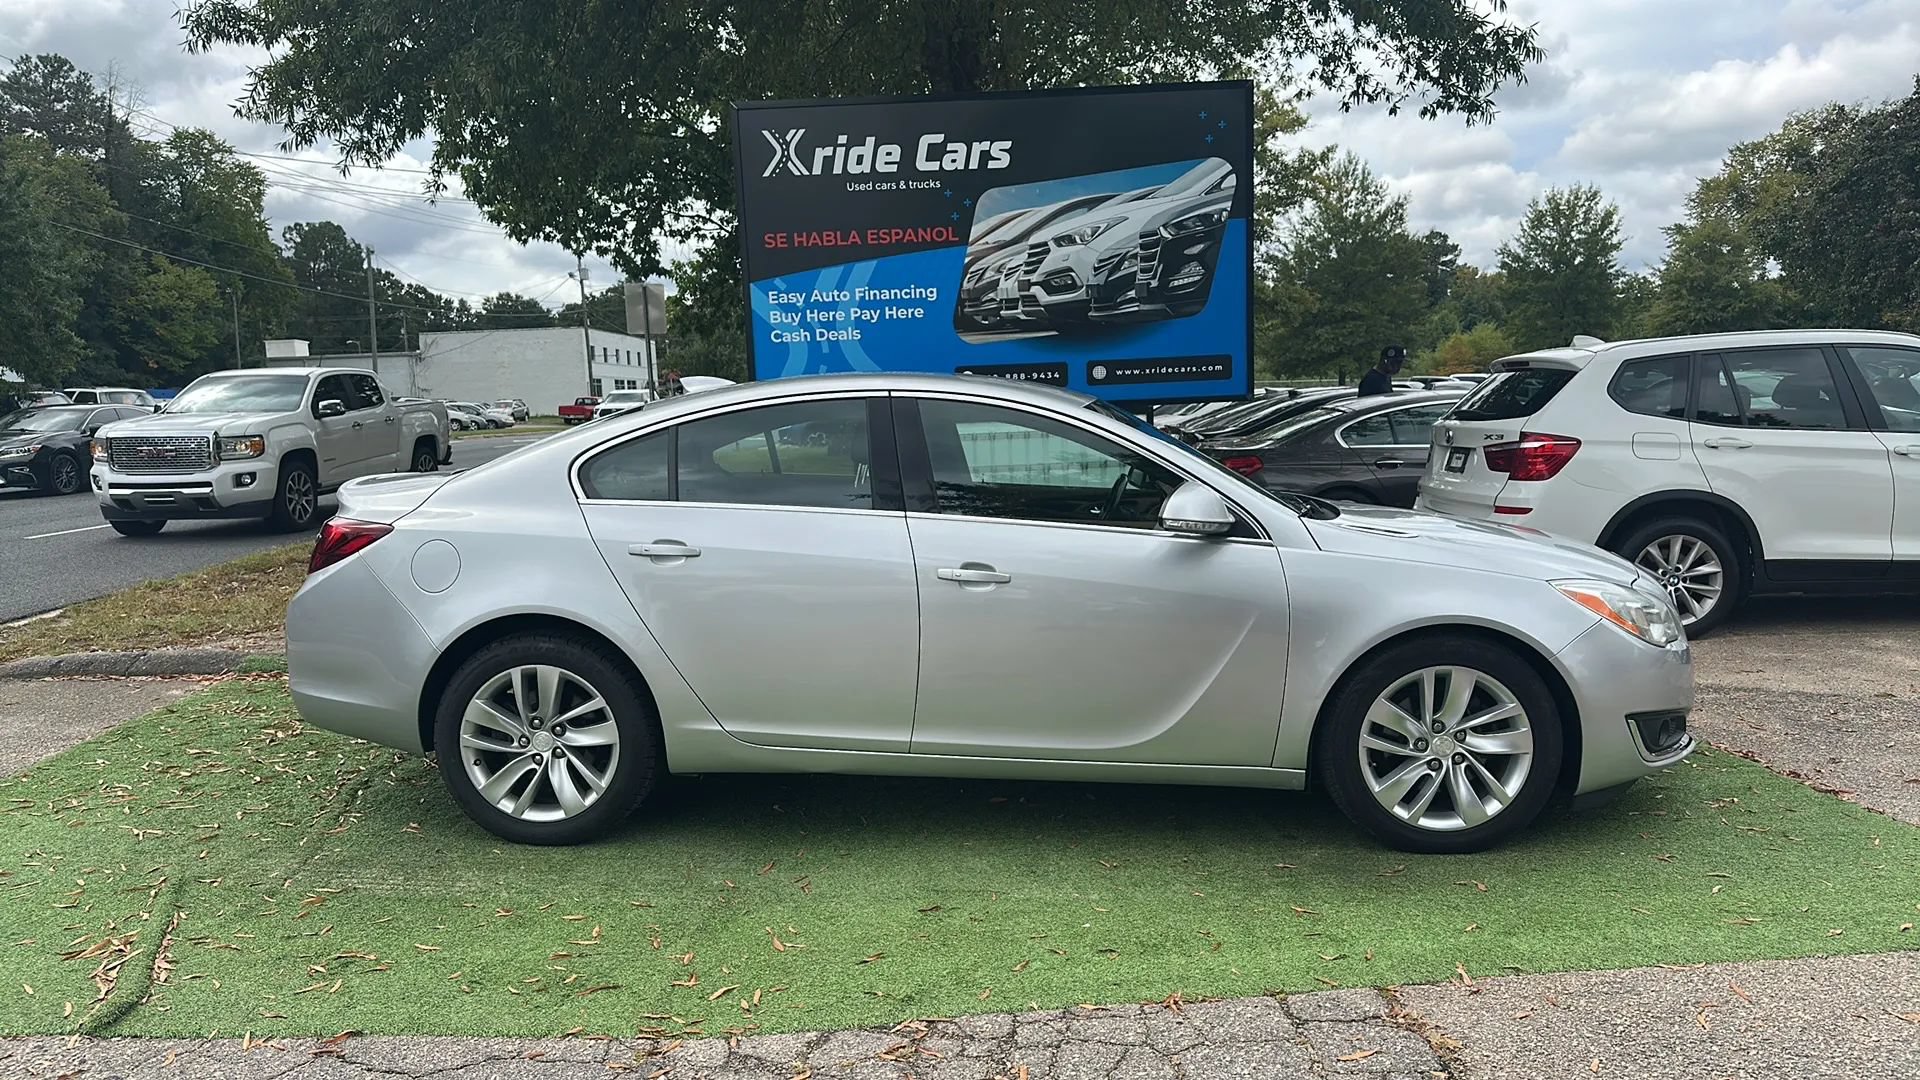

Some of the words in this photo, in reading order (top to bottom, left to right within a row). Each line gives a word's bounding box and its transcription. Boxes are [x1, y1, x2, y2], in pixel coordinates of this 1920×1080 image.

[761, 128, 902, 177] Xride
[915, 133, 1013, 172] Cars
[846, 181, 873, 192] Used
[875, 182, 897, 191] cars
[899, 180, 906, 190] &
[908, 179, 941, 190] trucks
[764, 233, 788, 248] SE
[794, 230, 862, 247] HABLA
[867, 227, 960, 245] ESPANOL
[768, 290, 806, 306] Easy
[810, 289, 850, 303] Auto
[855, 285, 938, 302] Financing
[769, 311, 802, 326] Buy
[806, 309, 846, 322] Here
[850, 308, 881, 323] Pay
[885, 306, 925, 320] Here
[770, 329, 811, 343] Cash
[816, 327, 862, 342] Deals
[1115, 365, 1223, 376] www.xridecars.com
[1483, 433, 1505, 441] X3
